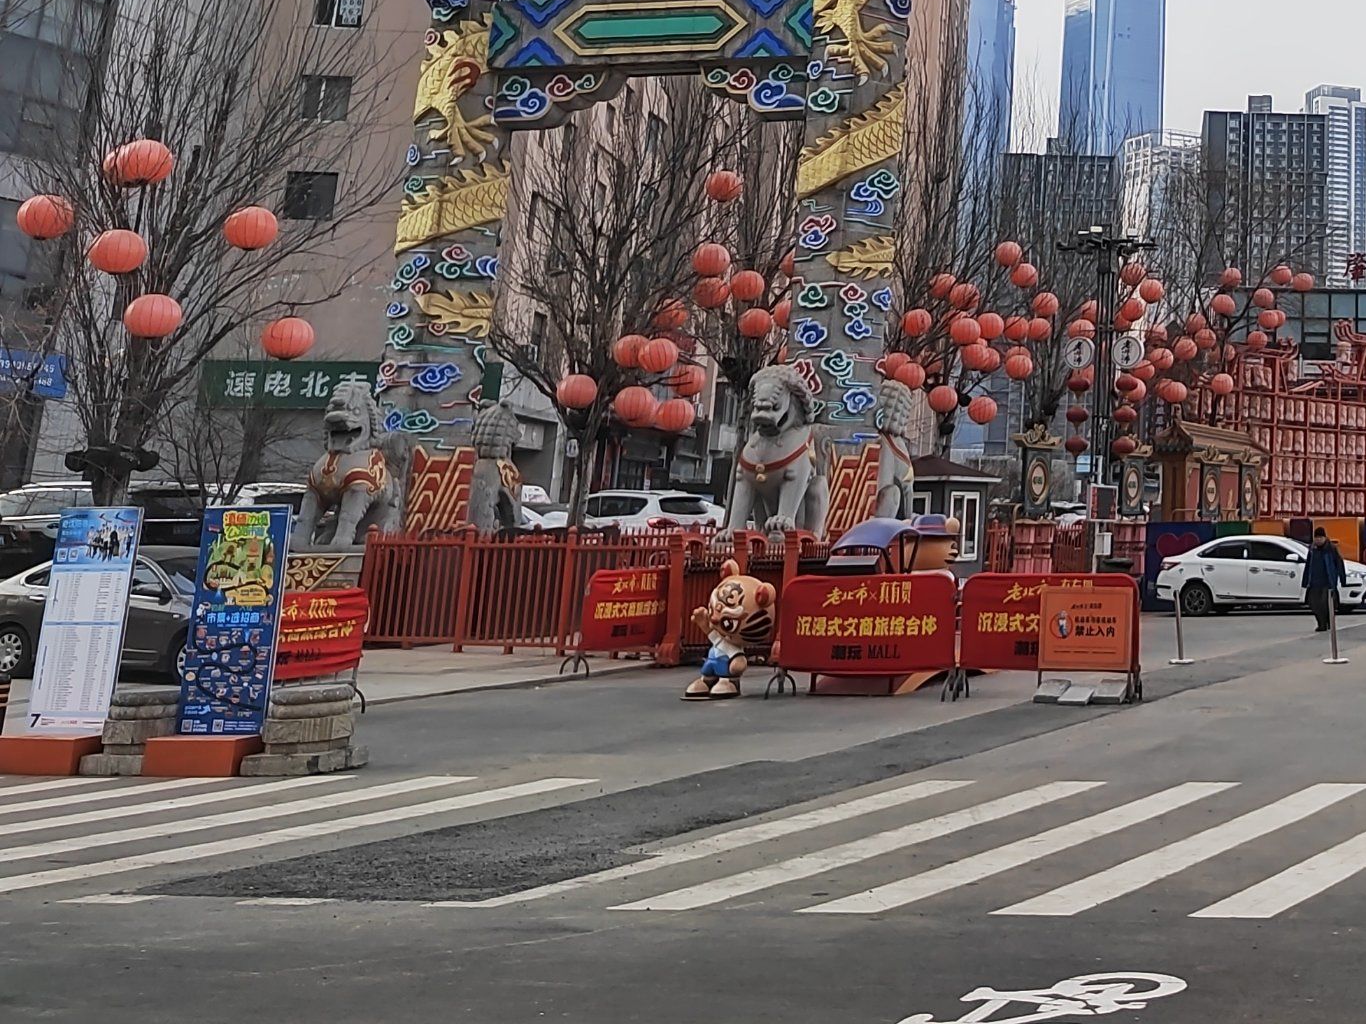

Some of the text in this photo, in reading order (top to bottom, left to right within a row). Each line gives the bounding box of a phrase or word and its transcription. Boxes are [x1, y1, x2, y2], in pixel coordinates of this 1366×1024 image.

[796, 614, 938, 637] 沉浸式文商旅综合体
[1074, 625, 1115, 638] 禁止入内
